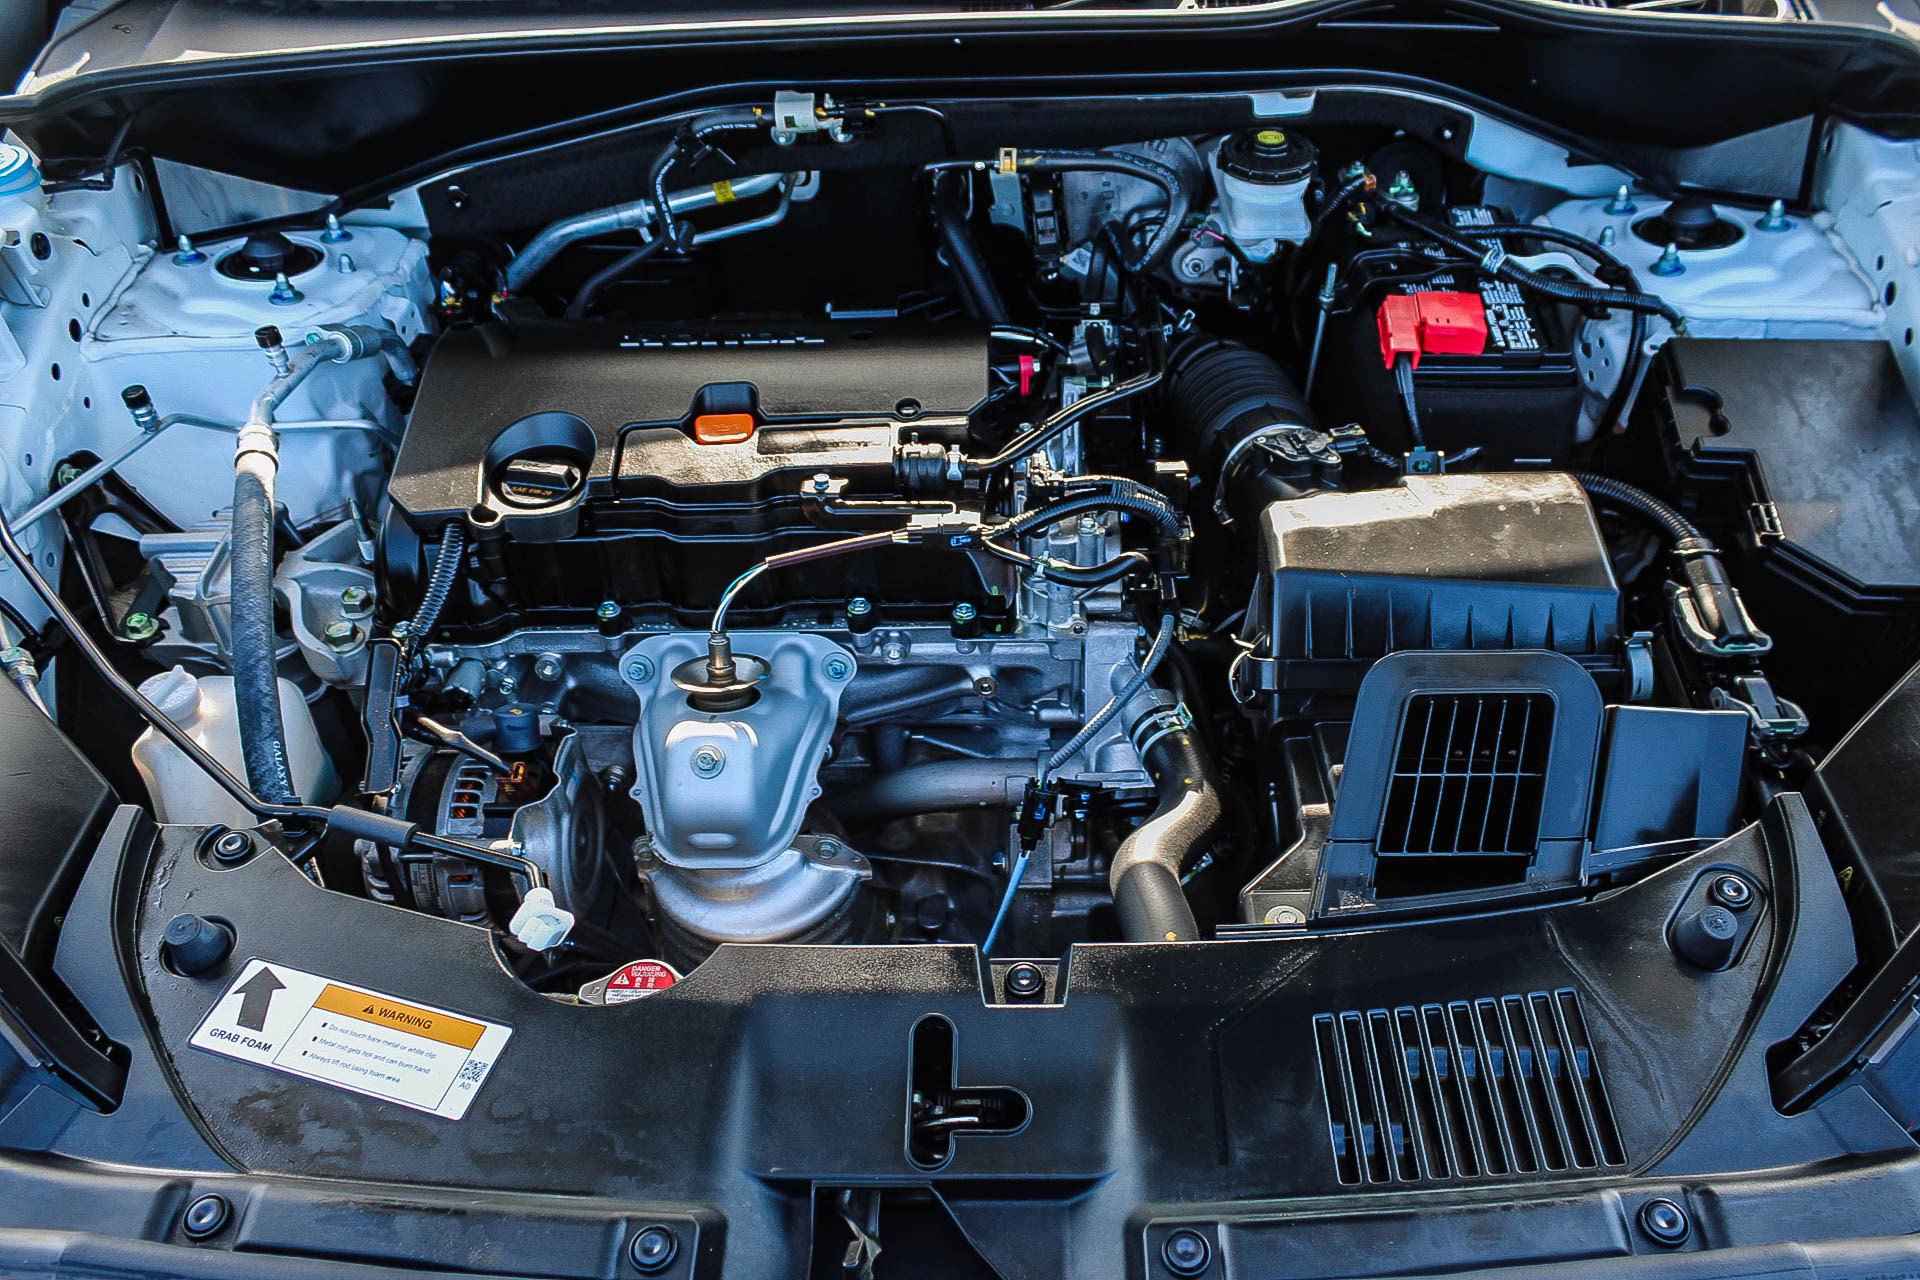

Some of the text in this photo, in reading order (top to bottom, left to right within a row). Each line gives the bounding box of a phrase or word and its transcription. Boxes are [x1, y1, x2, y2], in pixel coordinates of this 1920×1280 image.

[273, 740, 289, 787] GALAXY
[378, 1007, 433, 1030] WARNING
[209, 1028, 272, 1052] GRAB FOAM
[328, 1023, 338, 1031] Do
[349, 1030, 367, 1039] touch
[367, 1034, 381, 1043] bare
[382, 1039, 400, 1048] metal
[309, 1052, 331, 1063] Always
[351, 1064, 368, 1075] using
[369, 1069, 386, 1078] foam
[319, 1038, 337, 1047] Metal
[347, 1047, 361, 1055] gets
[373, 1053, 386, 1061] and
[399, 1060, 413, 1069] burn
